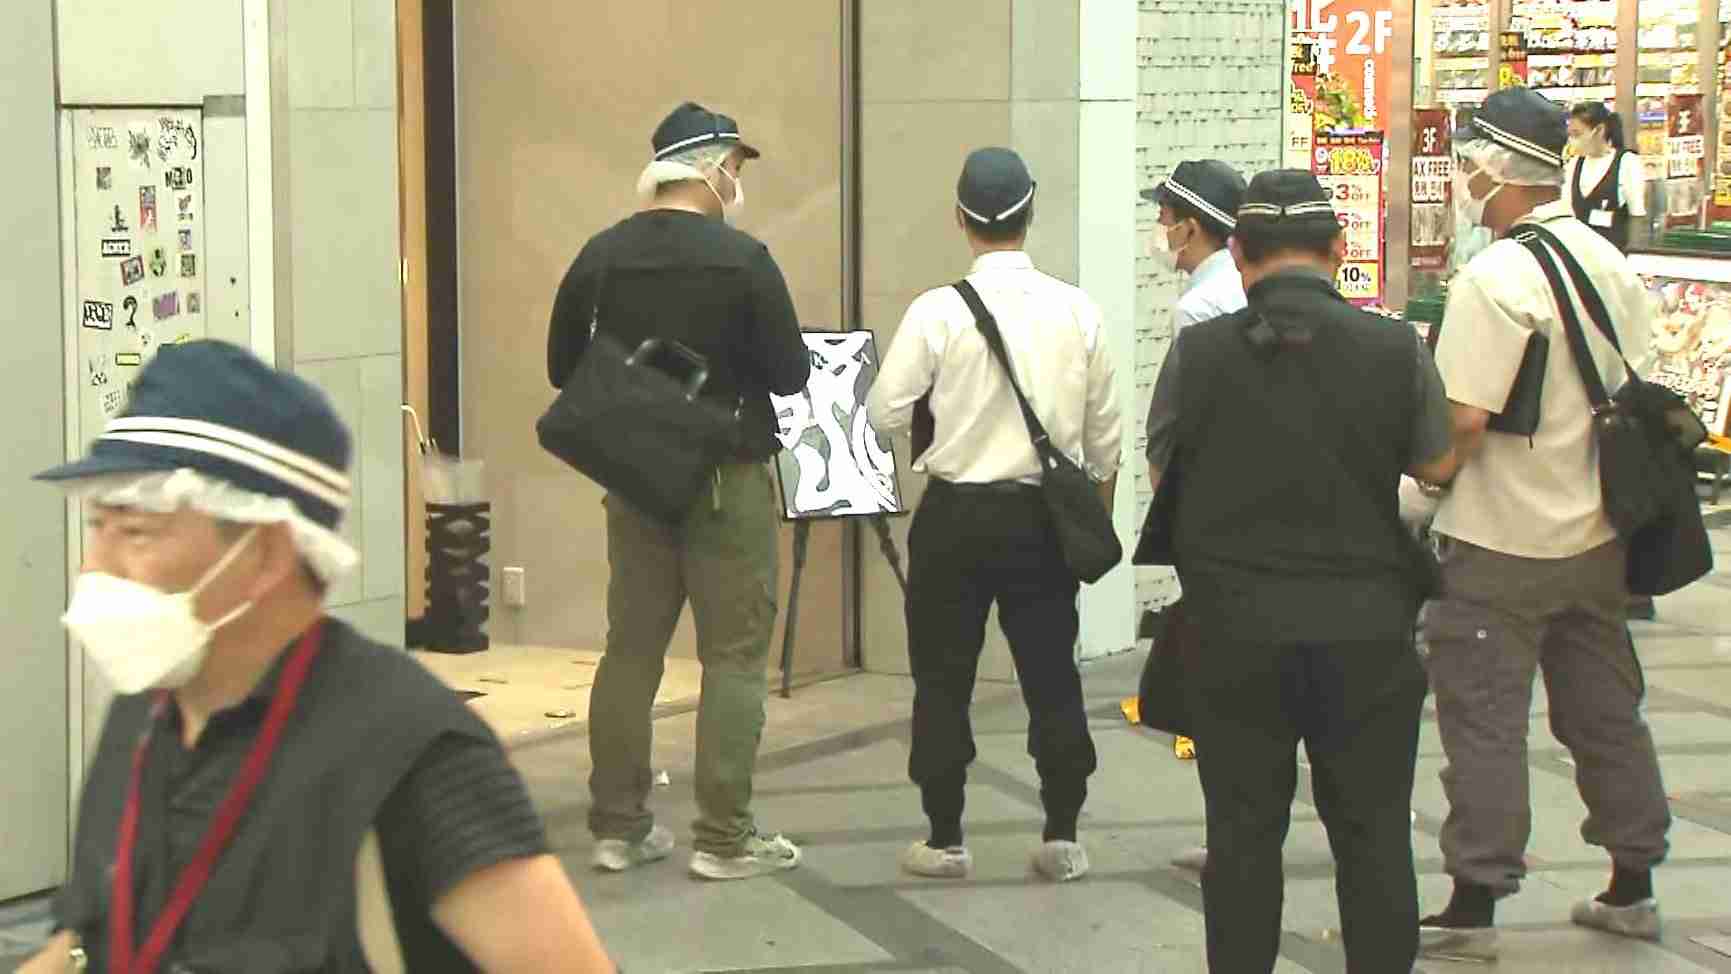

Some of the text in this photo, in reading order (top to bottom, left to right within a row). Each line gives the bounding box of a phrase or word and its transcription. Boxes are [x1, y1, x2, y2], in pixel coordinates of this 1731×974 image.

[1344, 10, 1392, 54] 2F
[1422, 127, 1437, 152] 3F
[1428, 160, 1449, 177] FREE
[1341, 266, 1371, 282] 10%
